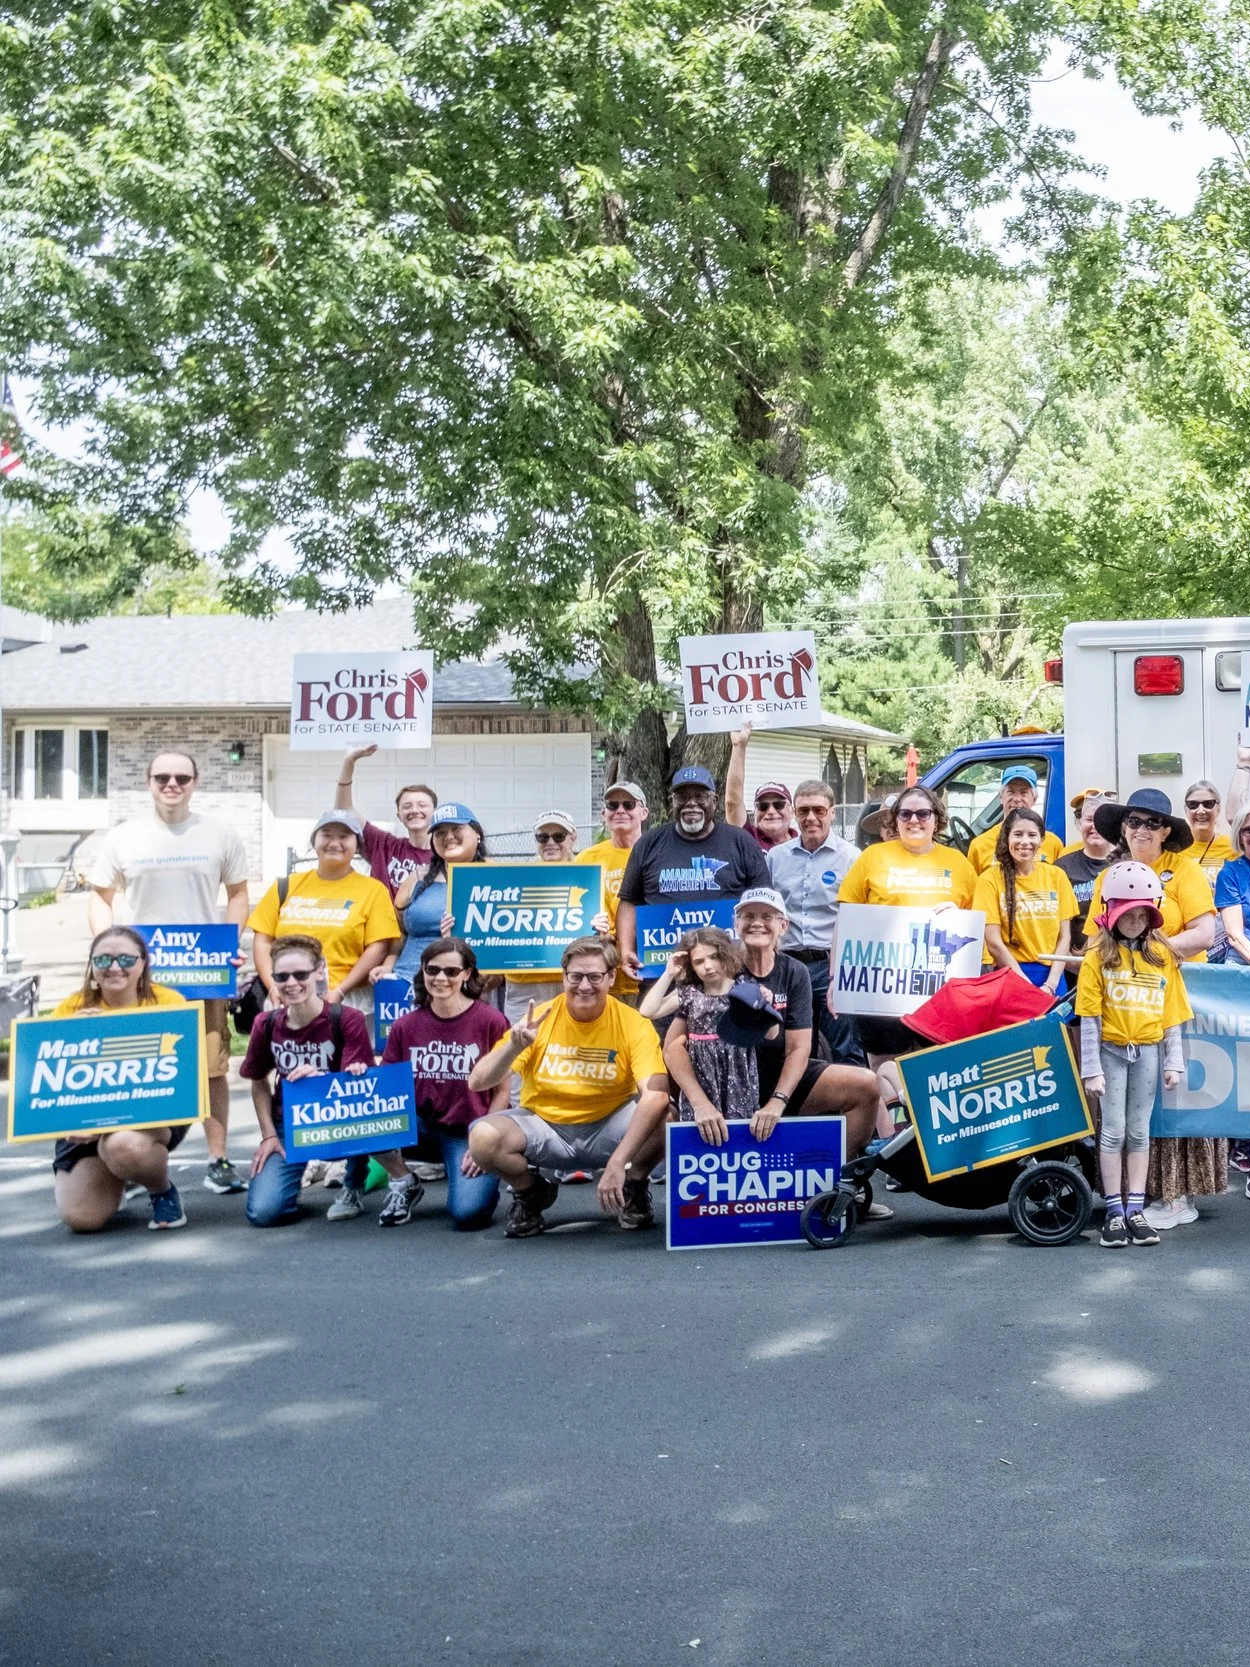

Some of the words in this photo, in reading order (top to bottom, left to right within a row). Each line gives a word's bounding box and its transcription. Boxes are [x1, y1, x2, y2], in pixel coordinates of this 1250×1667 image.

[722, 649, 784, 670] Chris
[335, 669, 398, 688] Chris
[685, 657, 806, 705] Ford
[295, 677, 418, 721] Ford
[689, 707, 709, 717] for
[712, 704, 752, 715] STATE
[757, 700, 808, 712] SENATE
[294, 724, 314, 734] for
[318, 723, 359, 734] STATE
[364, 721, 418, 732] SENATE
[659, 868, 704, 881] AMANDA
[469, 885, 521, 902] Matt
[463, 903, 584, 933] NORRIS
[669, 907, 715, 927] Amy
[148, 928, 201, 950] Amy
[466, 937, 484, 947] For
[484, 936, 544, 947] Minnesota
[545, 935, 578, 946] Hous
[149, 949, 232, 968] obuchar
[840, 939, 928, 970] AMANDA
[152, 969, 222, 984] GOVERNOR
[1107, 980, 1165, 1006] ORRIS
[38, 1037, 101, 1060] Matt
[283, 1039, 318, 1053] Chris
[428, 1040, 463, 1054] Chris
[545, 1043, 578, 1056] Matt
[409, 1045, 471, 1073] Ford
[537, 1055, 618, 1080] NORRIS
[30, 1056, 179, 1094] NORRIS
[418, 1072, 441, 1080] STATE
[927, 1064, 980, 1094] Matt
[30, 1098, 56, 1110] For
[56, 1090, 130, 1106] Minnesota
[131, 1086, 175, 1100] House
[326, 1077, 378, 1099] Amy
[291, 1093, 409, 1126] Klobuchar
[929, 1069, 1057, 1130] NORRIS
[301, 1130, 331, 1144] FOR
[332, 1117, 402, 1138] GOVERNOR
[937, 1132, 958, 1145] For
[959, 1114, 1021, 1138] Minnesota
[1023, 1102, 1060, 1119] House
[678, 1151, 762, 1174] DOUG
[678, 1168, 834, 1202] CHAPIN
[699, 1205, 729, 1216] FOR
[734, 1200, 810, 1214] CONGRES
